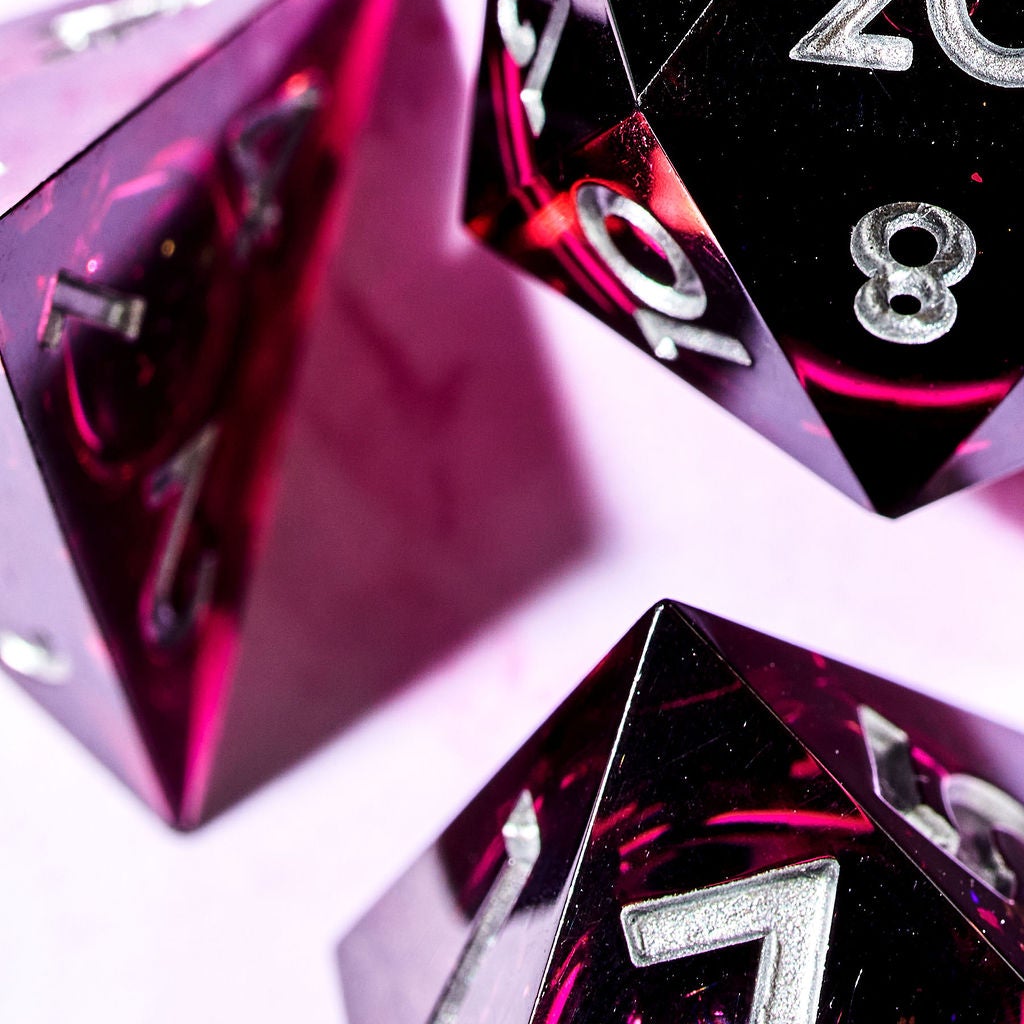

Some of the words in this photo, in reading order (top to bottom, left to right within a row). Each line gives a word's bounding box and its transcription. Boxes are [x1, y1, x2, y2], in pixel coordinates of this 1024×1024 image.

[573, 182, 753, 367] 10
[850, 202, 977, 345] 8
[620, 857, 841, 1024] 7
